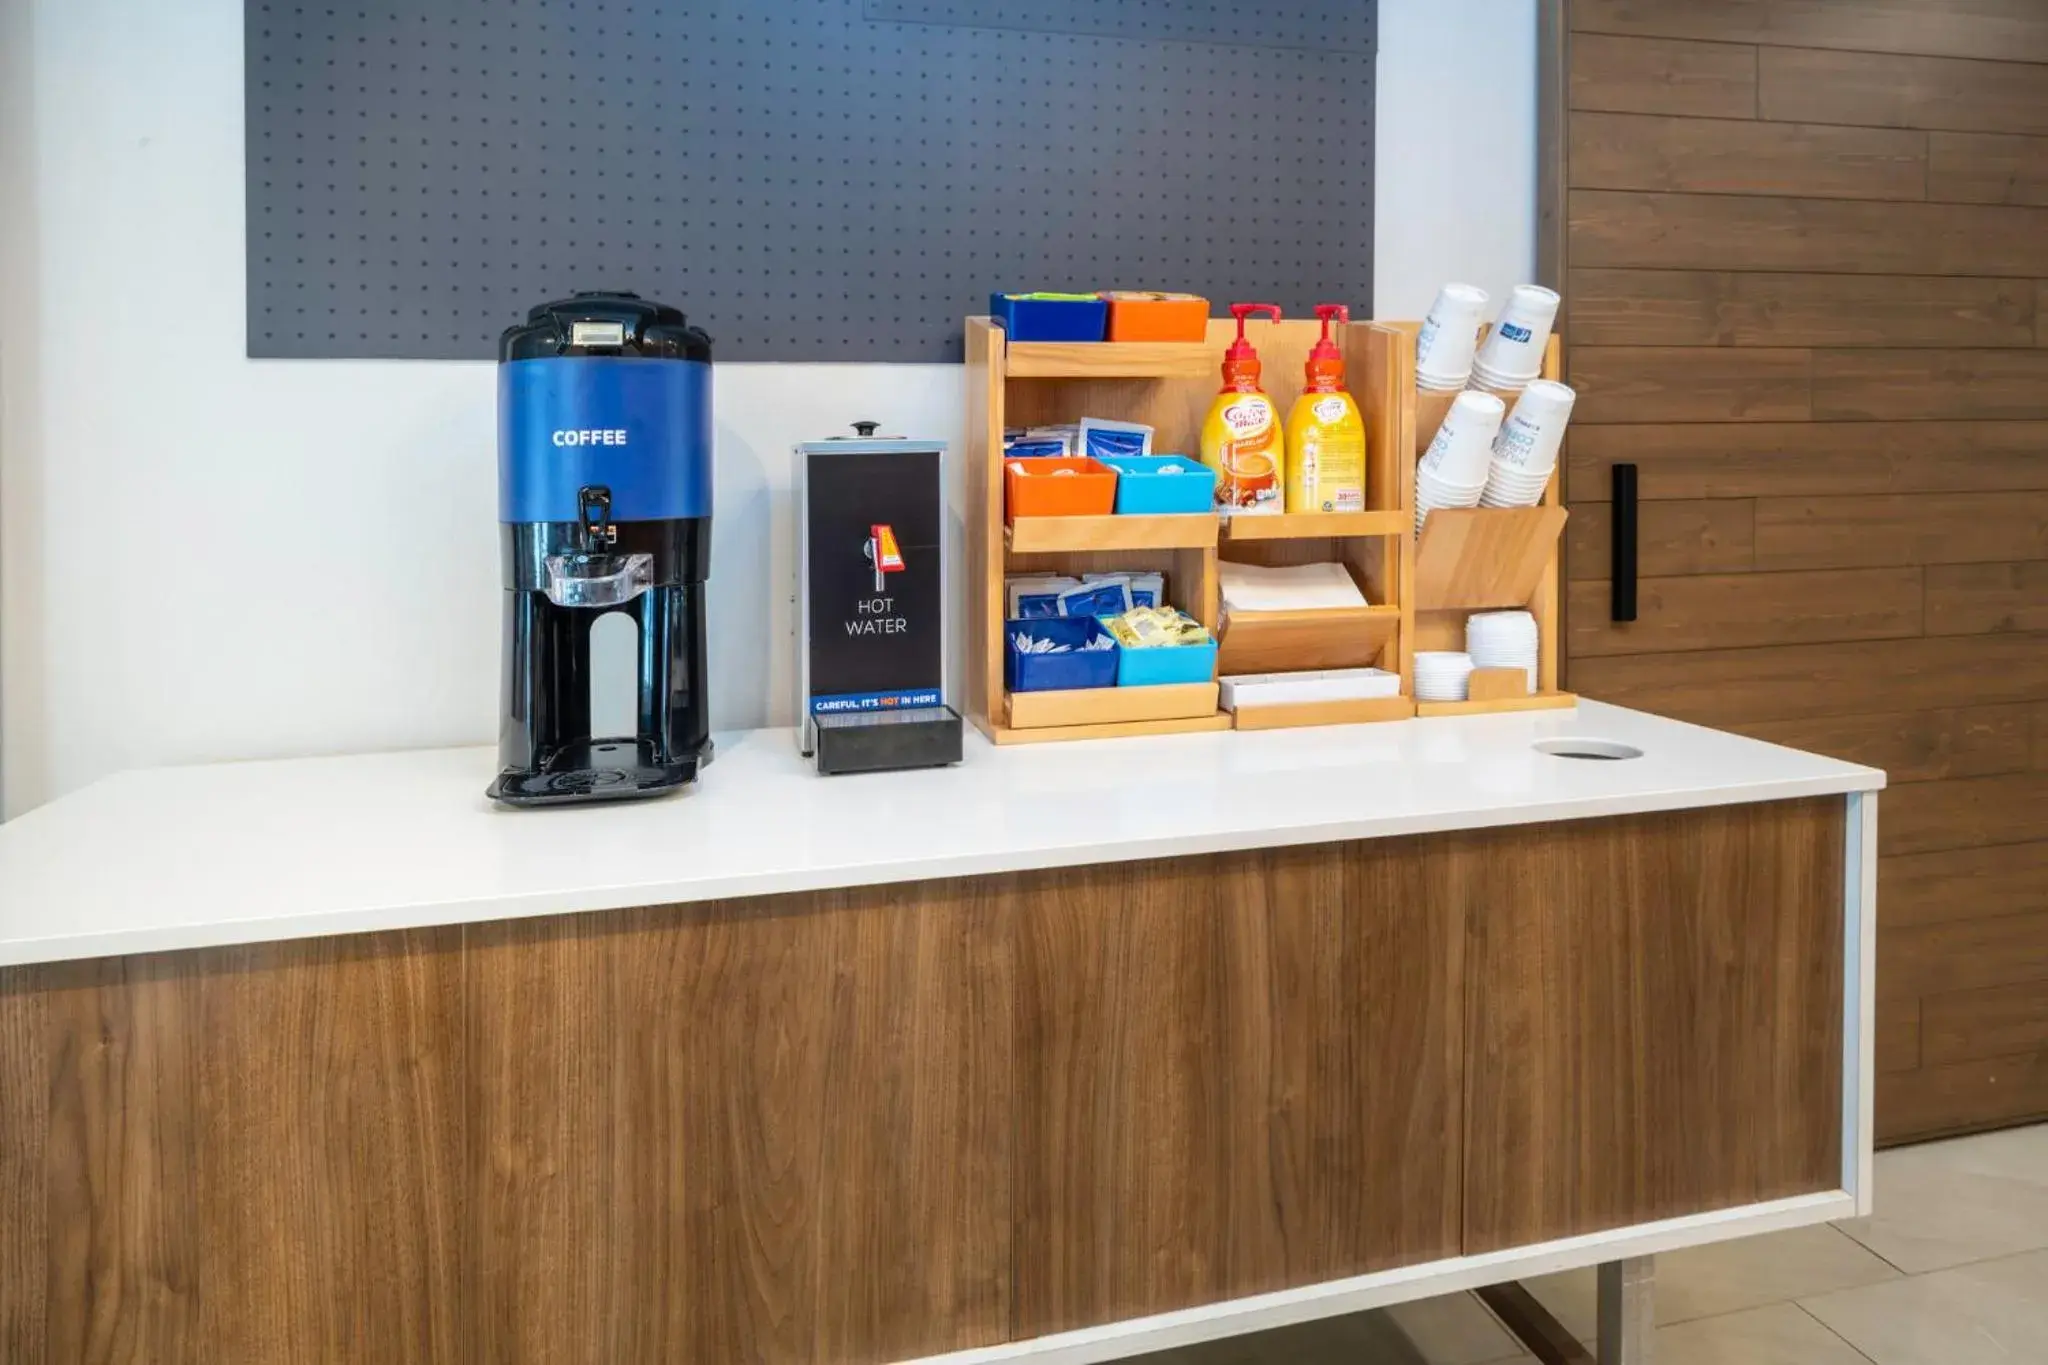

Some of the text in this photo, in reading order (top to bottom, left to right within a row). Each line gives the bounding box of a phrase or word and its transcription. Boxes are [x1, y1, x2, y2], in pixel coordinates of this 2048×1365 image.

[552, 429, 627, 447] COFFEE
[858, 598, 894, 614] HOT
[845, 618, 907, 636] WATER
[861, 698, 878, 707] IT'S
[880, 697, 900, 706] HOT
[901, 696, 911, 705] IN
[913, 694, 937, 704] HERE
